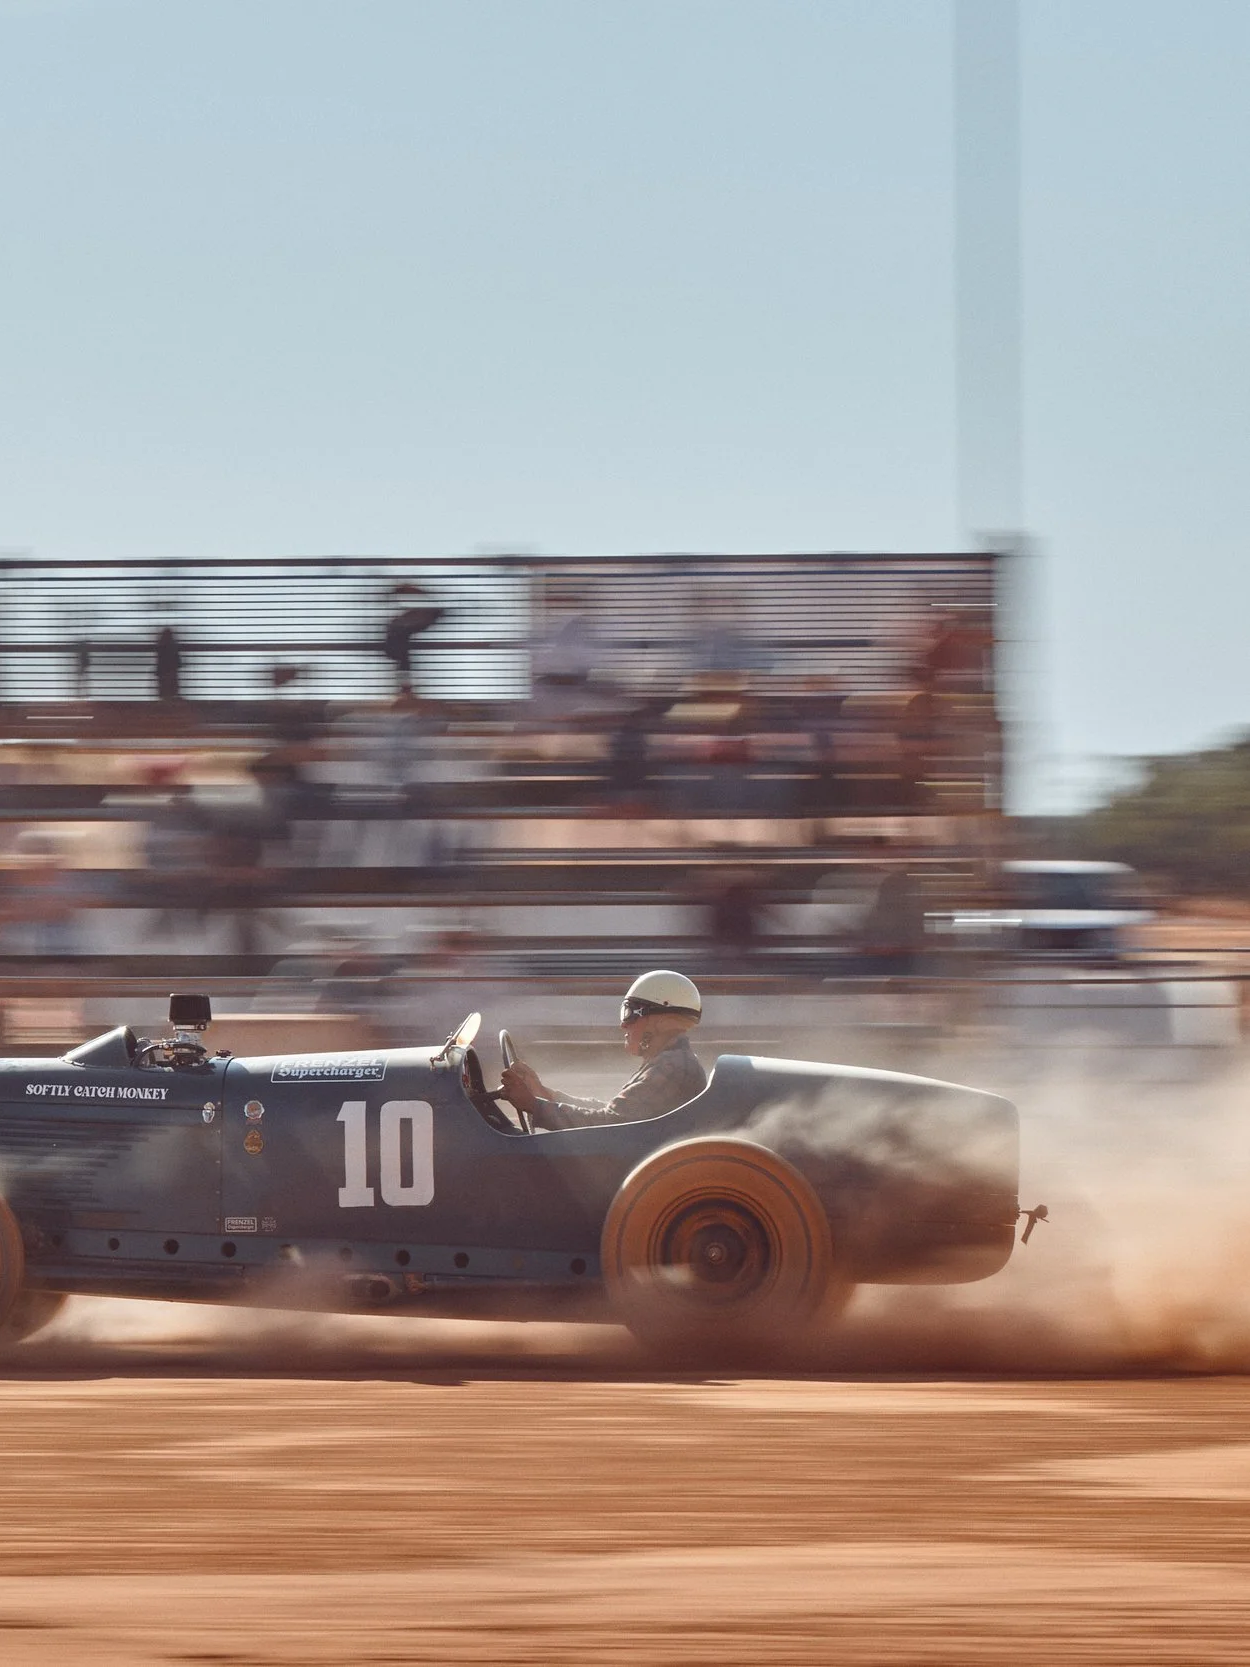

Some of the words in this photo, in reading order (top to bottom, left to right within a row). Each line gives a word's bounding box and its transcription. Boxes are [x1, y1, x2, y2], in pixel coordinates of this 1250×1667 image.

[280, 1057, 382, 1068] FRENZEL
[278, 1067, 379, 1079] Supercharger
[25, 1083, 72, 1097] SOFTLY
[73, 1085, 115, 1099] CATCH
[116, 1087, 168, 1100] MONKEY
[336, 1100, 434, 1208] 10
